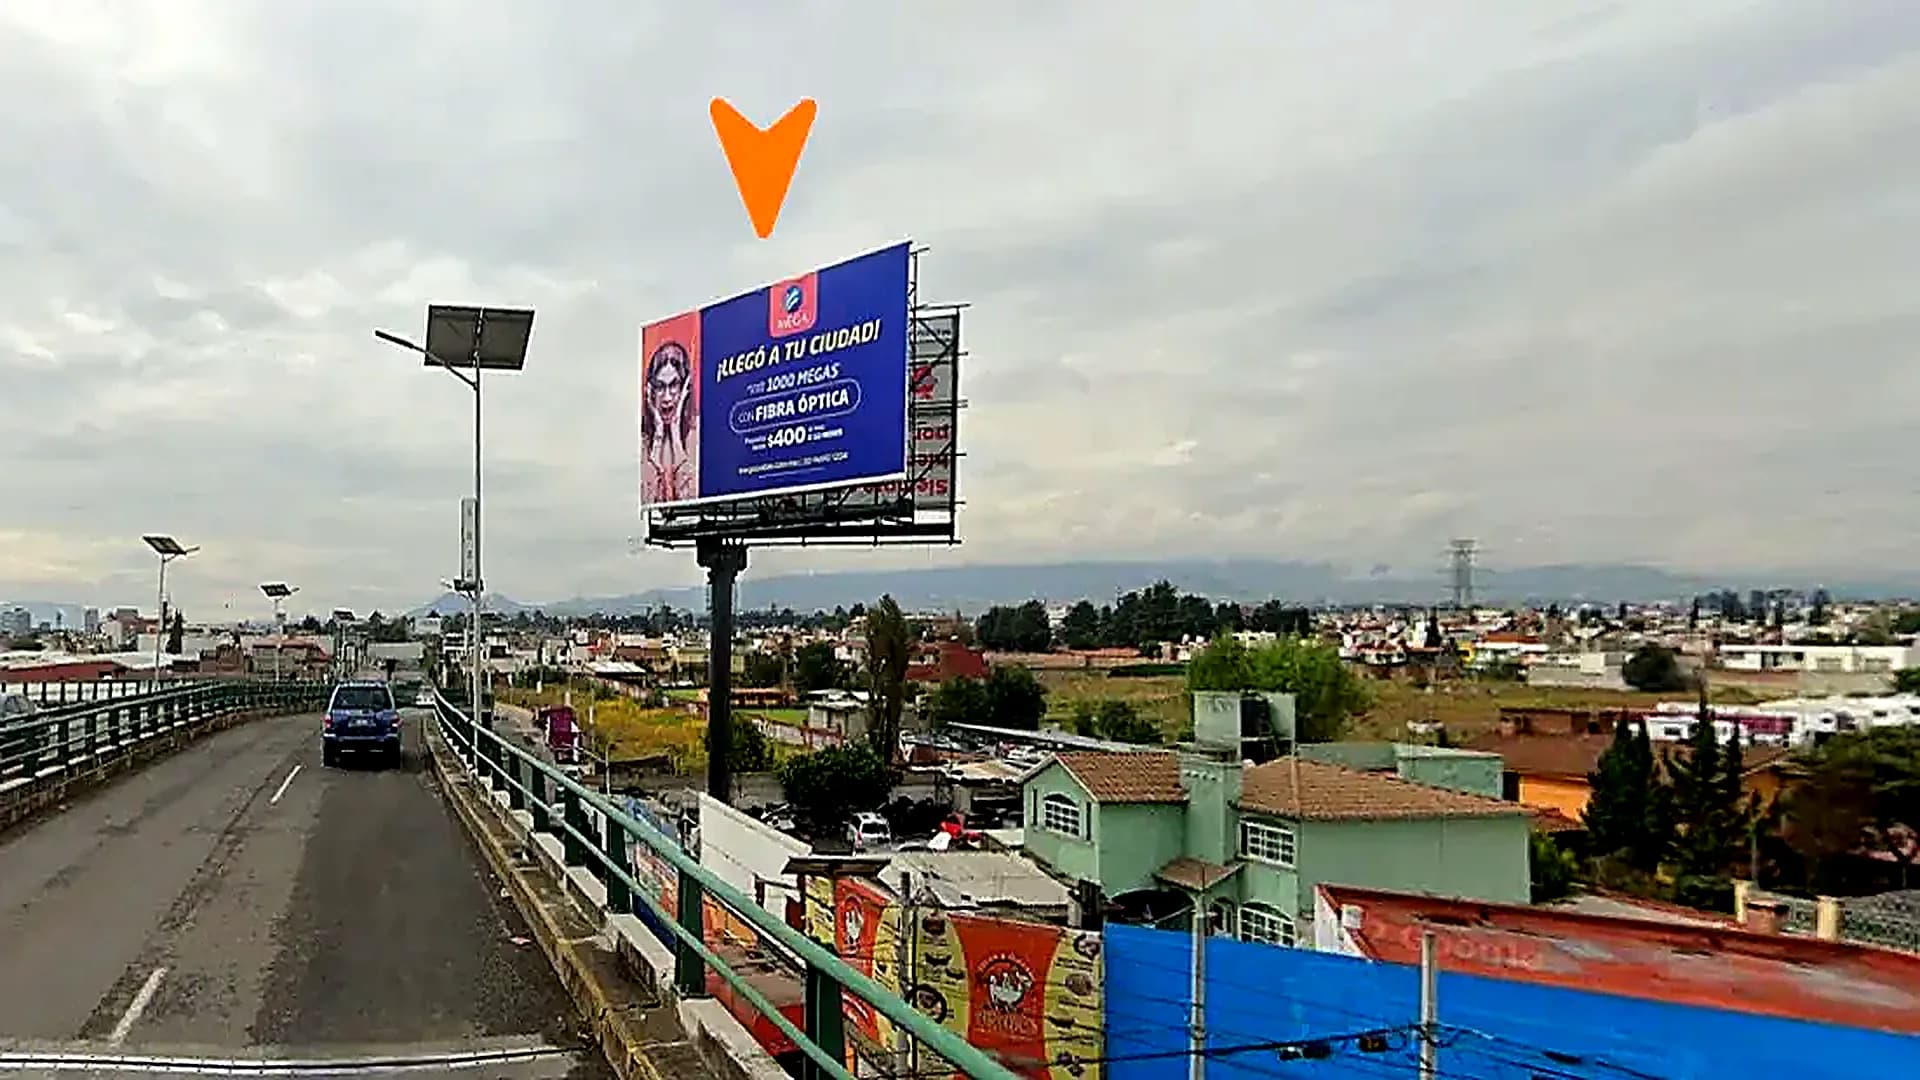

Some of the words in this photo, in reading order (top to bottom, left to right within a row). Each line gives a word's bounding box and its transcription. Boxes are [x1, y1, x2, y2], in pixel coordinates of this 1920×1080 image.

[716, 345, 767, 383] ¡LLEGÓ
[768, 345, 780, 366] A
[784, 339, 807, 361] TU
[809, 318, 881, 355] CIUDAD!
[766, 373, 796, 392] 1000
[796, 362, 841, 385] MEGAS
[755, 399, 795, 422] FIBRA
[797, 388, 849, 413] ÓPTICA
[767, 425, 807, 448] $400
